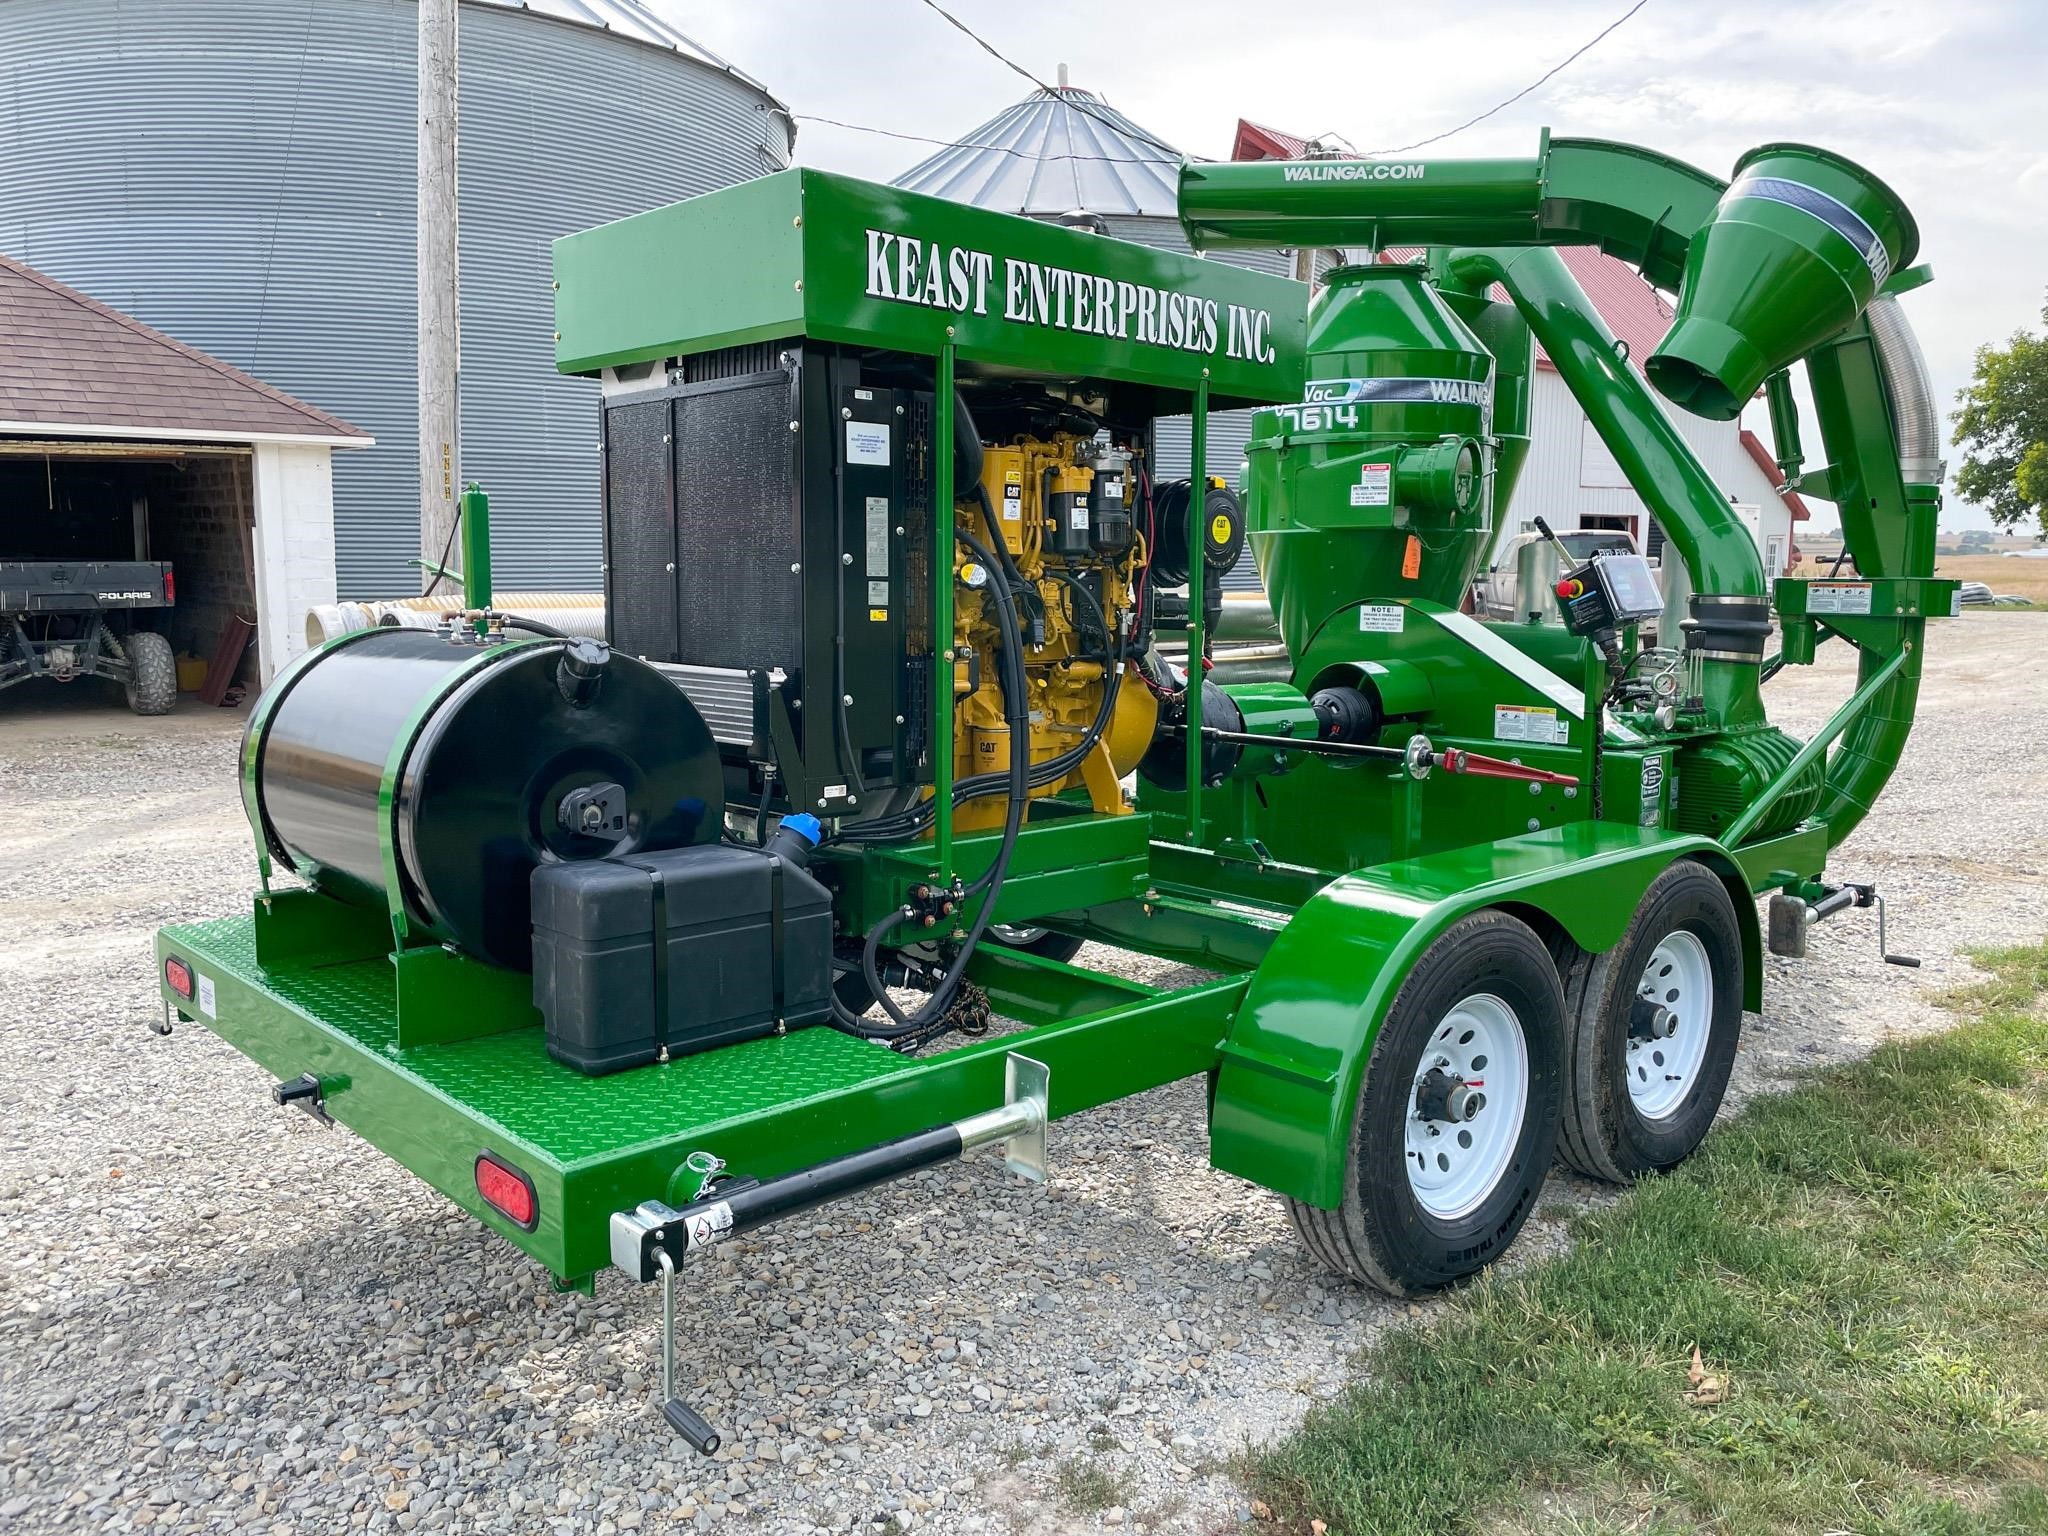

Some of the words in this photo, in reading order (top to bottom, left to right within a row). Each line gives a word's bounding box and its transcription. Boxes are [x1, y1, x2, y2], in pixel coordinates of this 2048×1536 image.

[1284, 165, 1425, 181] WALINGA.COM
[864, 228, 993, 316] KEAST
[1003, 257, 1219, 355] ENTERPRISES
[1225, 303, 1276, 366] INC.
[1283, 406, 1359, 431] 7614
[1007, 486, 1021, 497] CAT
[1076, 496, 1088, 507] CAT
[1216, 519, 1226, 529] CAT
[98, 591, 152, 600] POLARIS
[980, 742, 998, 753] CAT
